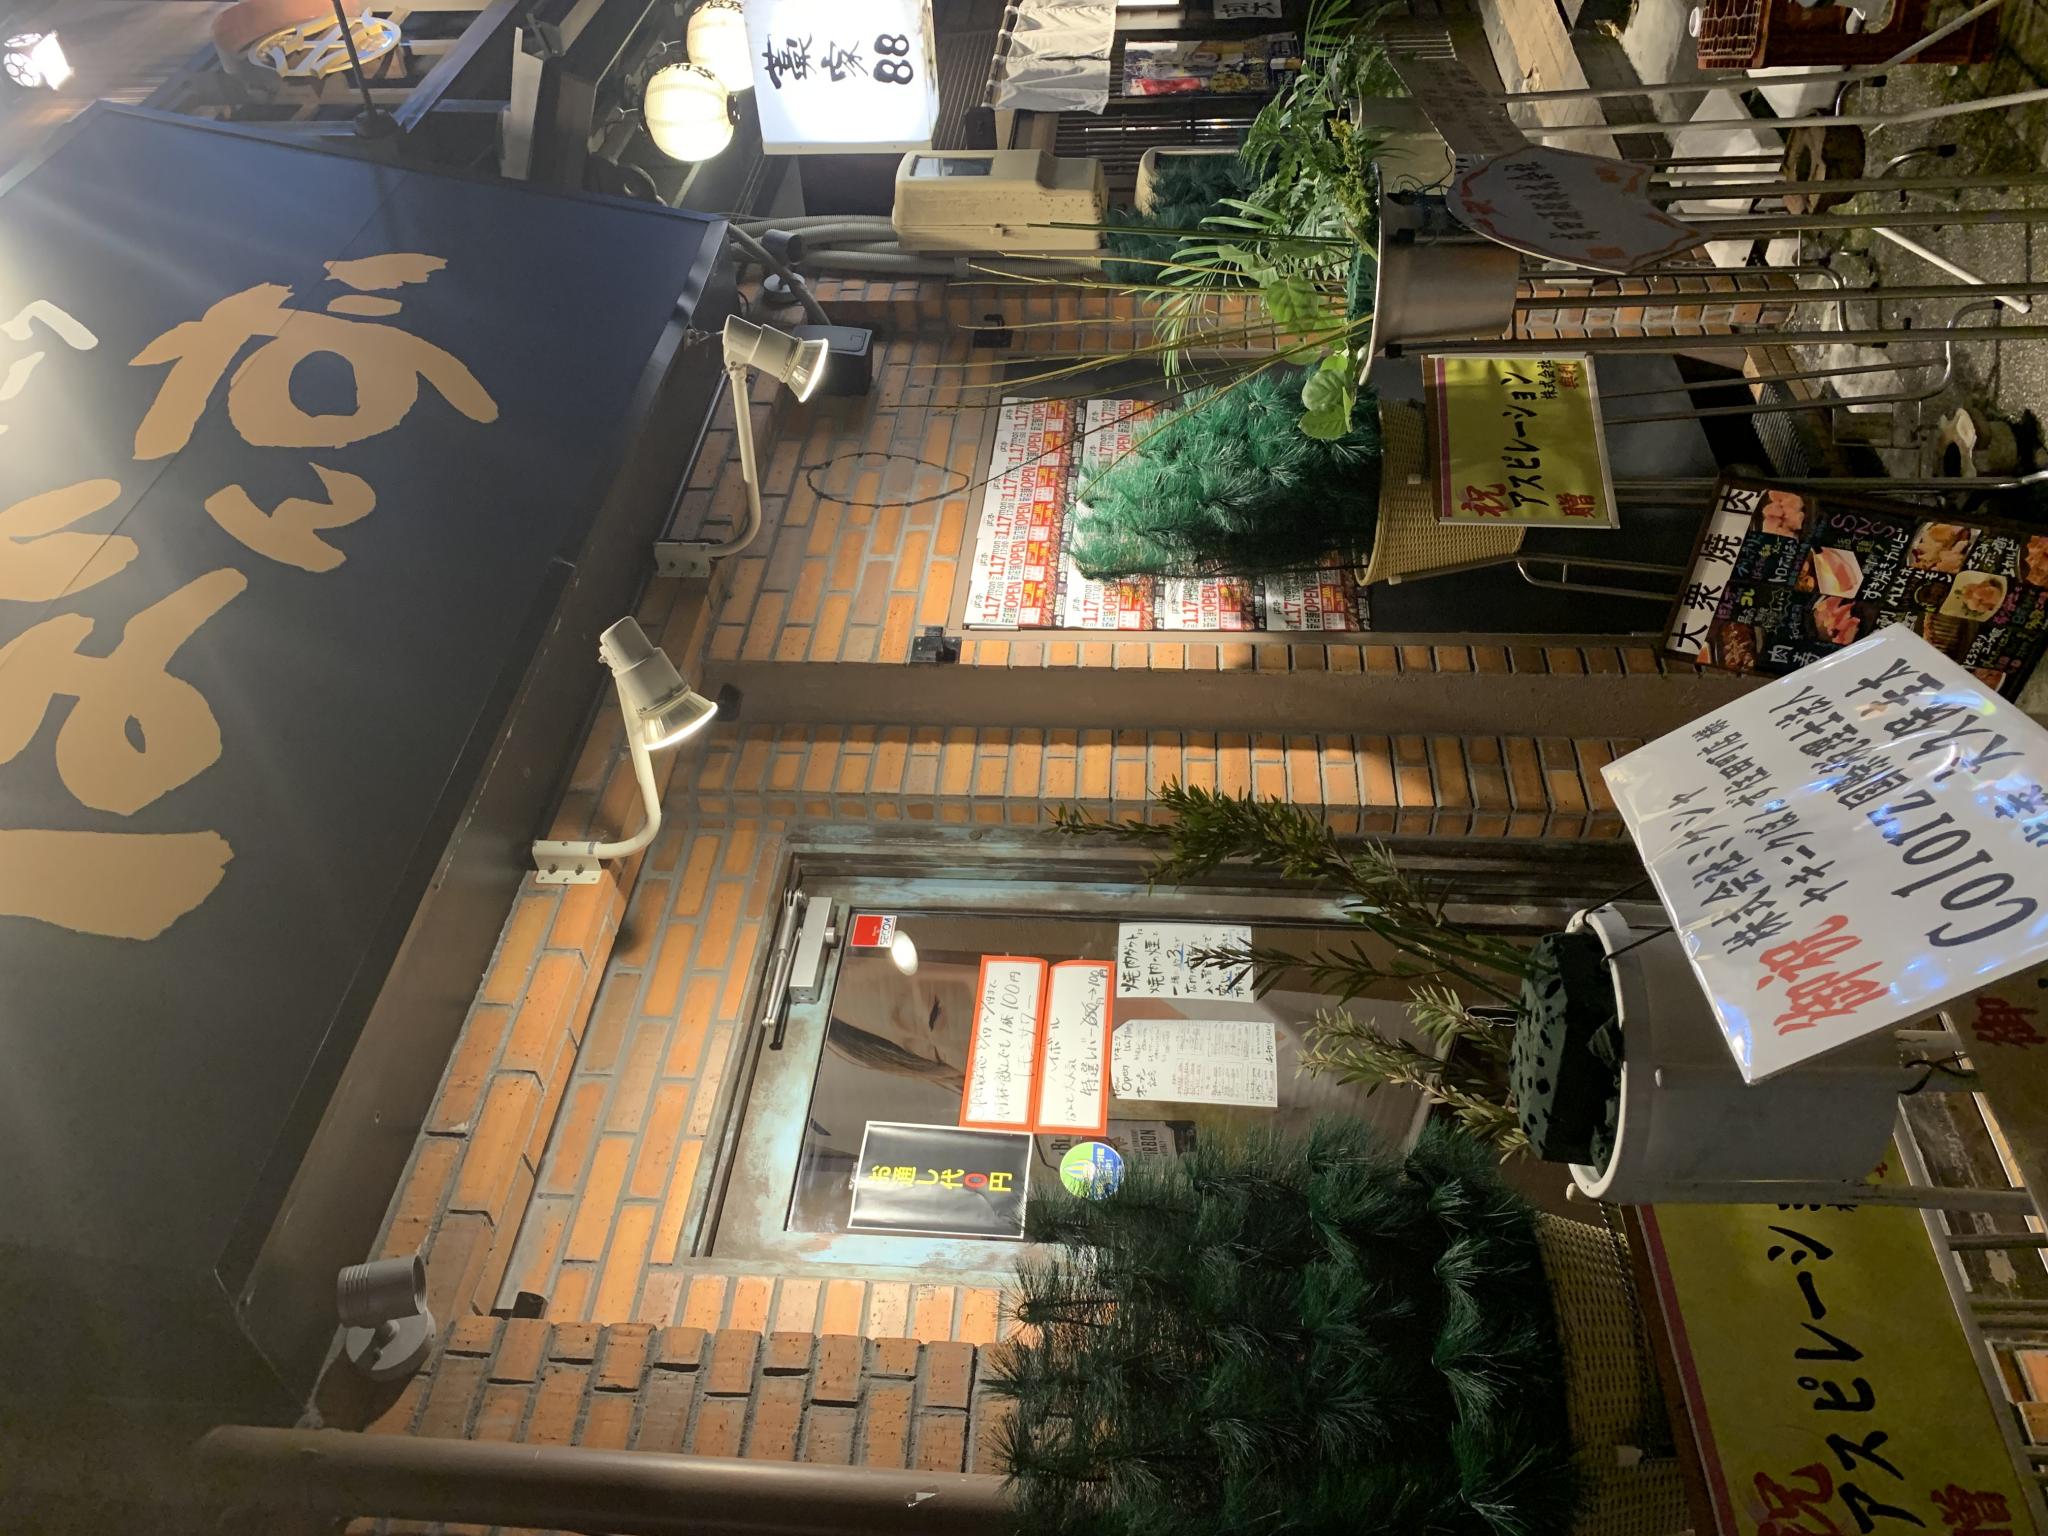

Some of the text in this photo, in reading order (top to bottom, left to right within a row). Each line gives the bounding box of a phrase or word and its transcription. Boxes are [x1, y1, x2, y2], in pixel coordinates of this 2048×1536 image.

[1536, 360, 1558, 400] 株式会社
[1008, 442, 1024, 462] 1.17
[1027, 432, 1041, 452] OPEN
[1500, 371, 1549, 508] アスピレーション
[1002, 478, 1018, 498] 1.17
[1020, 466, 1036, 488] OPEN
[1460, 483, 1509, 517] 祝
[1556, 493, 1596, 518] 贈
[994, 516, 1012, 536] 1.17
[1014, 503, 1032, 525] OPEN
[988, 555, 1006, 576] 1.17
[1009, 541, 1026, 566] OPEN
[1671, 488, 1760, 650] 大衆焼肉
[982, 595, 1000, 619] 1.17
[1004, 582, 1022, 608] OPEN
[1202, 585, 1218, 612] OPEN
[1304, 586, 1320, 612] OPEN
[1082, 600, 1099, 624] 1.17
[1182, 600, 1198, 624] 1.17
[1284, 601, 1301, 625] 1.17
[1668, 787, 1793, 954] 株式会社ミケシャ
[880, 918, 892, 945] SECOM
[1756, 915, 1889, 1035] 御祝
[1121, 1065, 1133, 1092] Open
[867, 1165, 1013, 1192] お通し代0円
[1767, 1203, 1926, 1535] アスピレーシ
